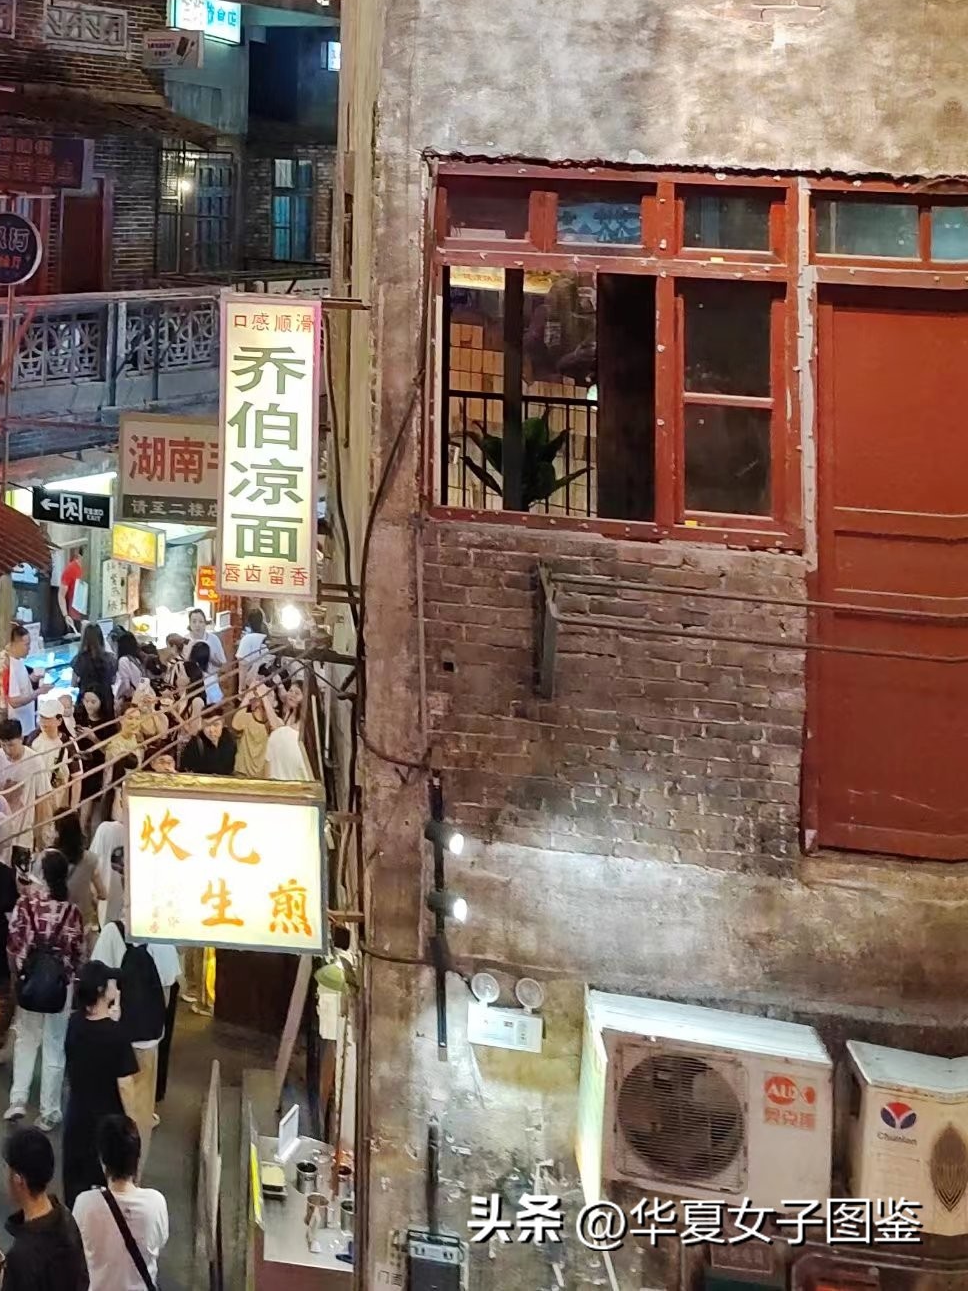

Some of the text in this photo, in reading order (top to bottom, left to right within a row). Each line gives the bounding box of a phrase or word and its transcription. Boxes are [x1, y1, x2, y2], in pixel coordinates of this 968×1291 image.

[233, 312, 315, 334] 口感顺滑
[227, 346, 306, 563] 乔伯凉面
[224, 562, 309, 587] 唇齿留香
